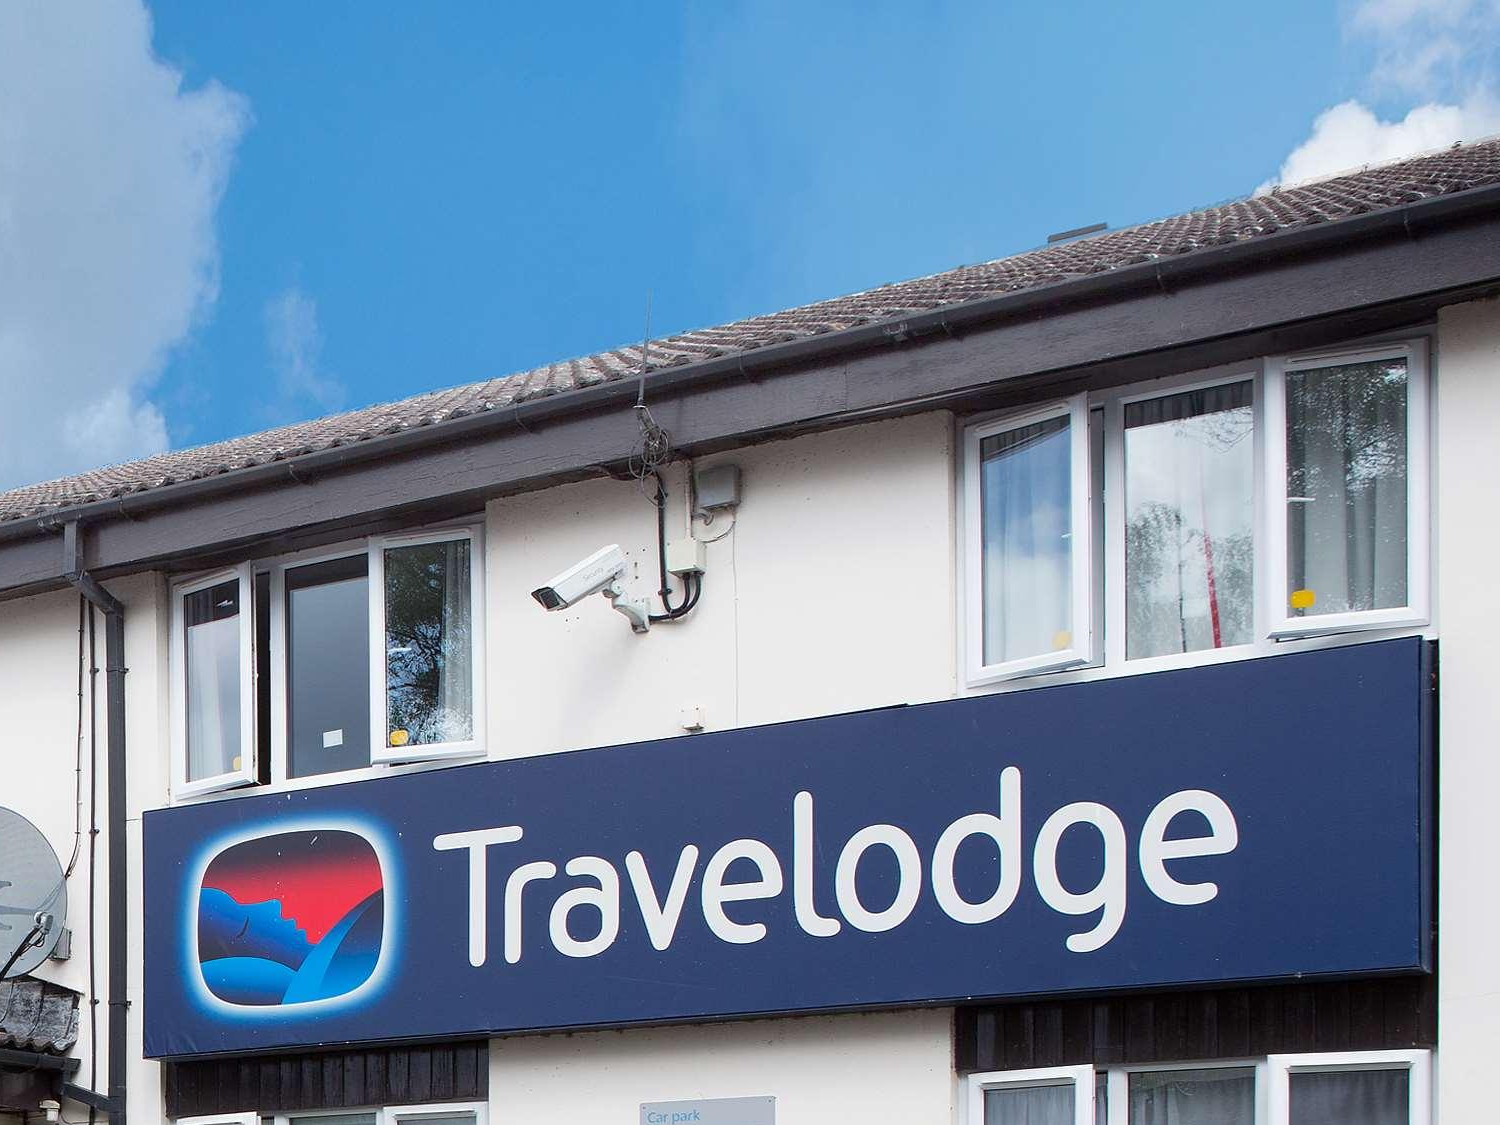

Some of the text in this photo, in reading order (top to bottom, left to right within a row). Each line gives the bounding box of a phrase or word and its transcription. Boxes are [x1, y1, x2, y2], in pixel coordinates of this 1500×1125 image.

[432, 766, 1239, 967] Travelodge
[647, 1110, 700, 1125] Car park
